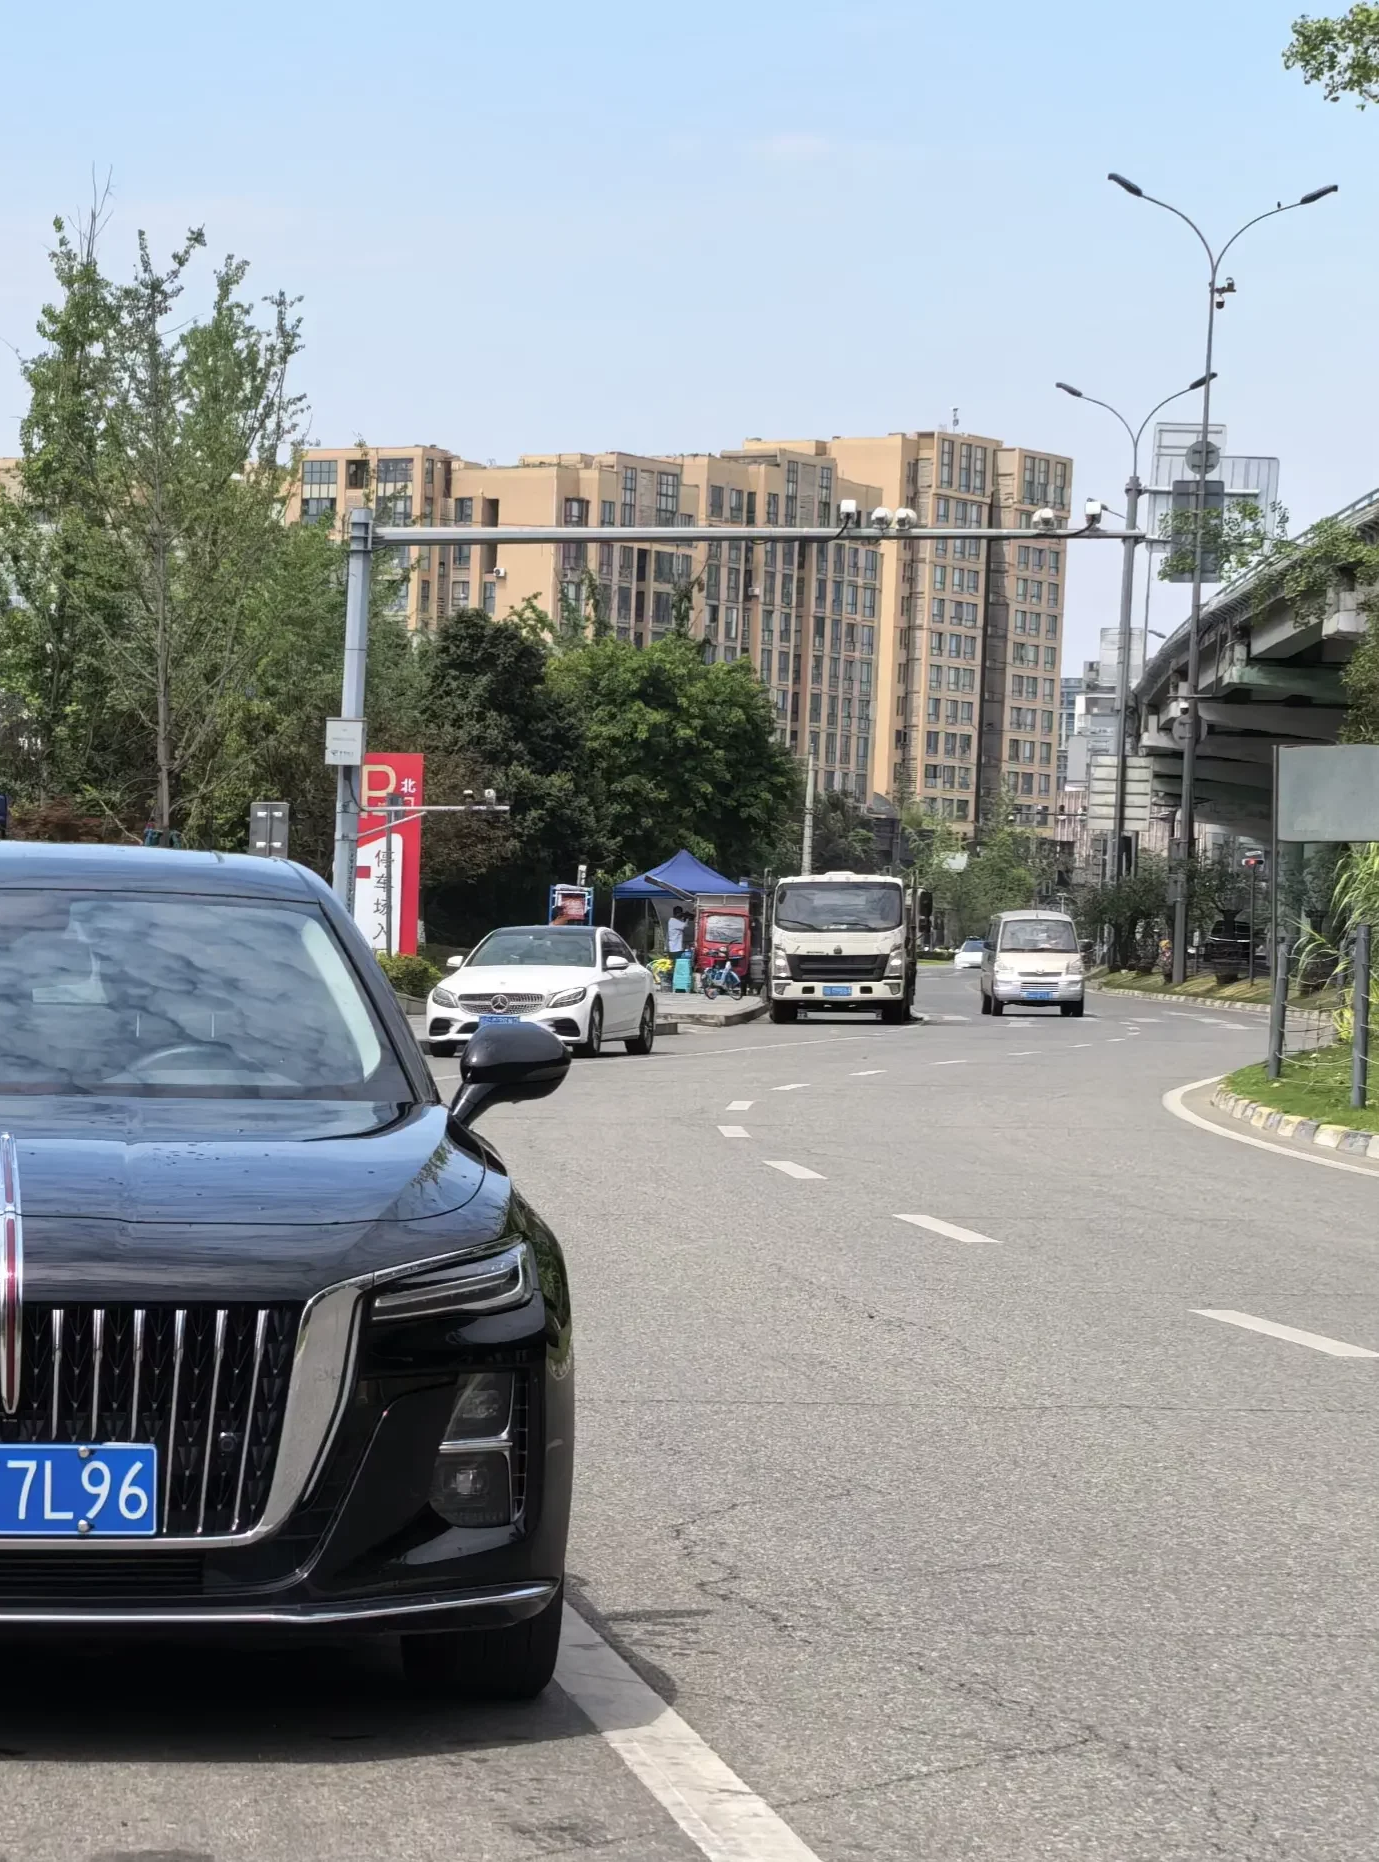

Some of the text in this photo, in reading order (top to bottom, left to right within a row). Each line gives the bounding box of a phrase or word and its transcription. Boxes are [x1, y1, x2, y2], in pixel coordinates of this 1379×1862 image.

[361, 765, 396, 819] P
[373, 849, 395, 954] 停车场入
